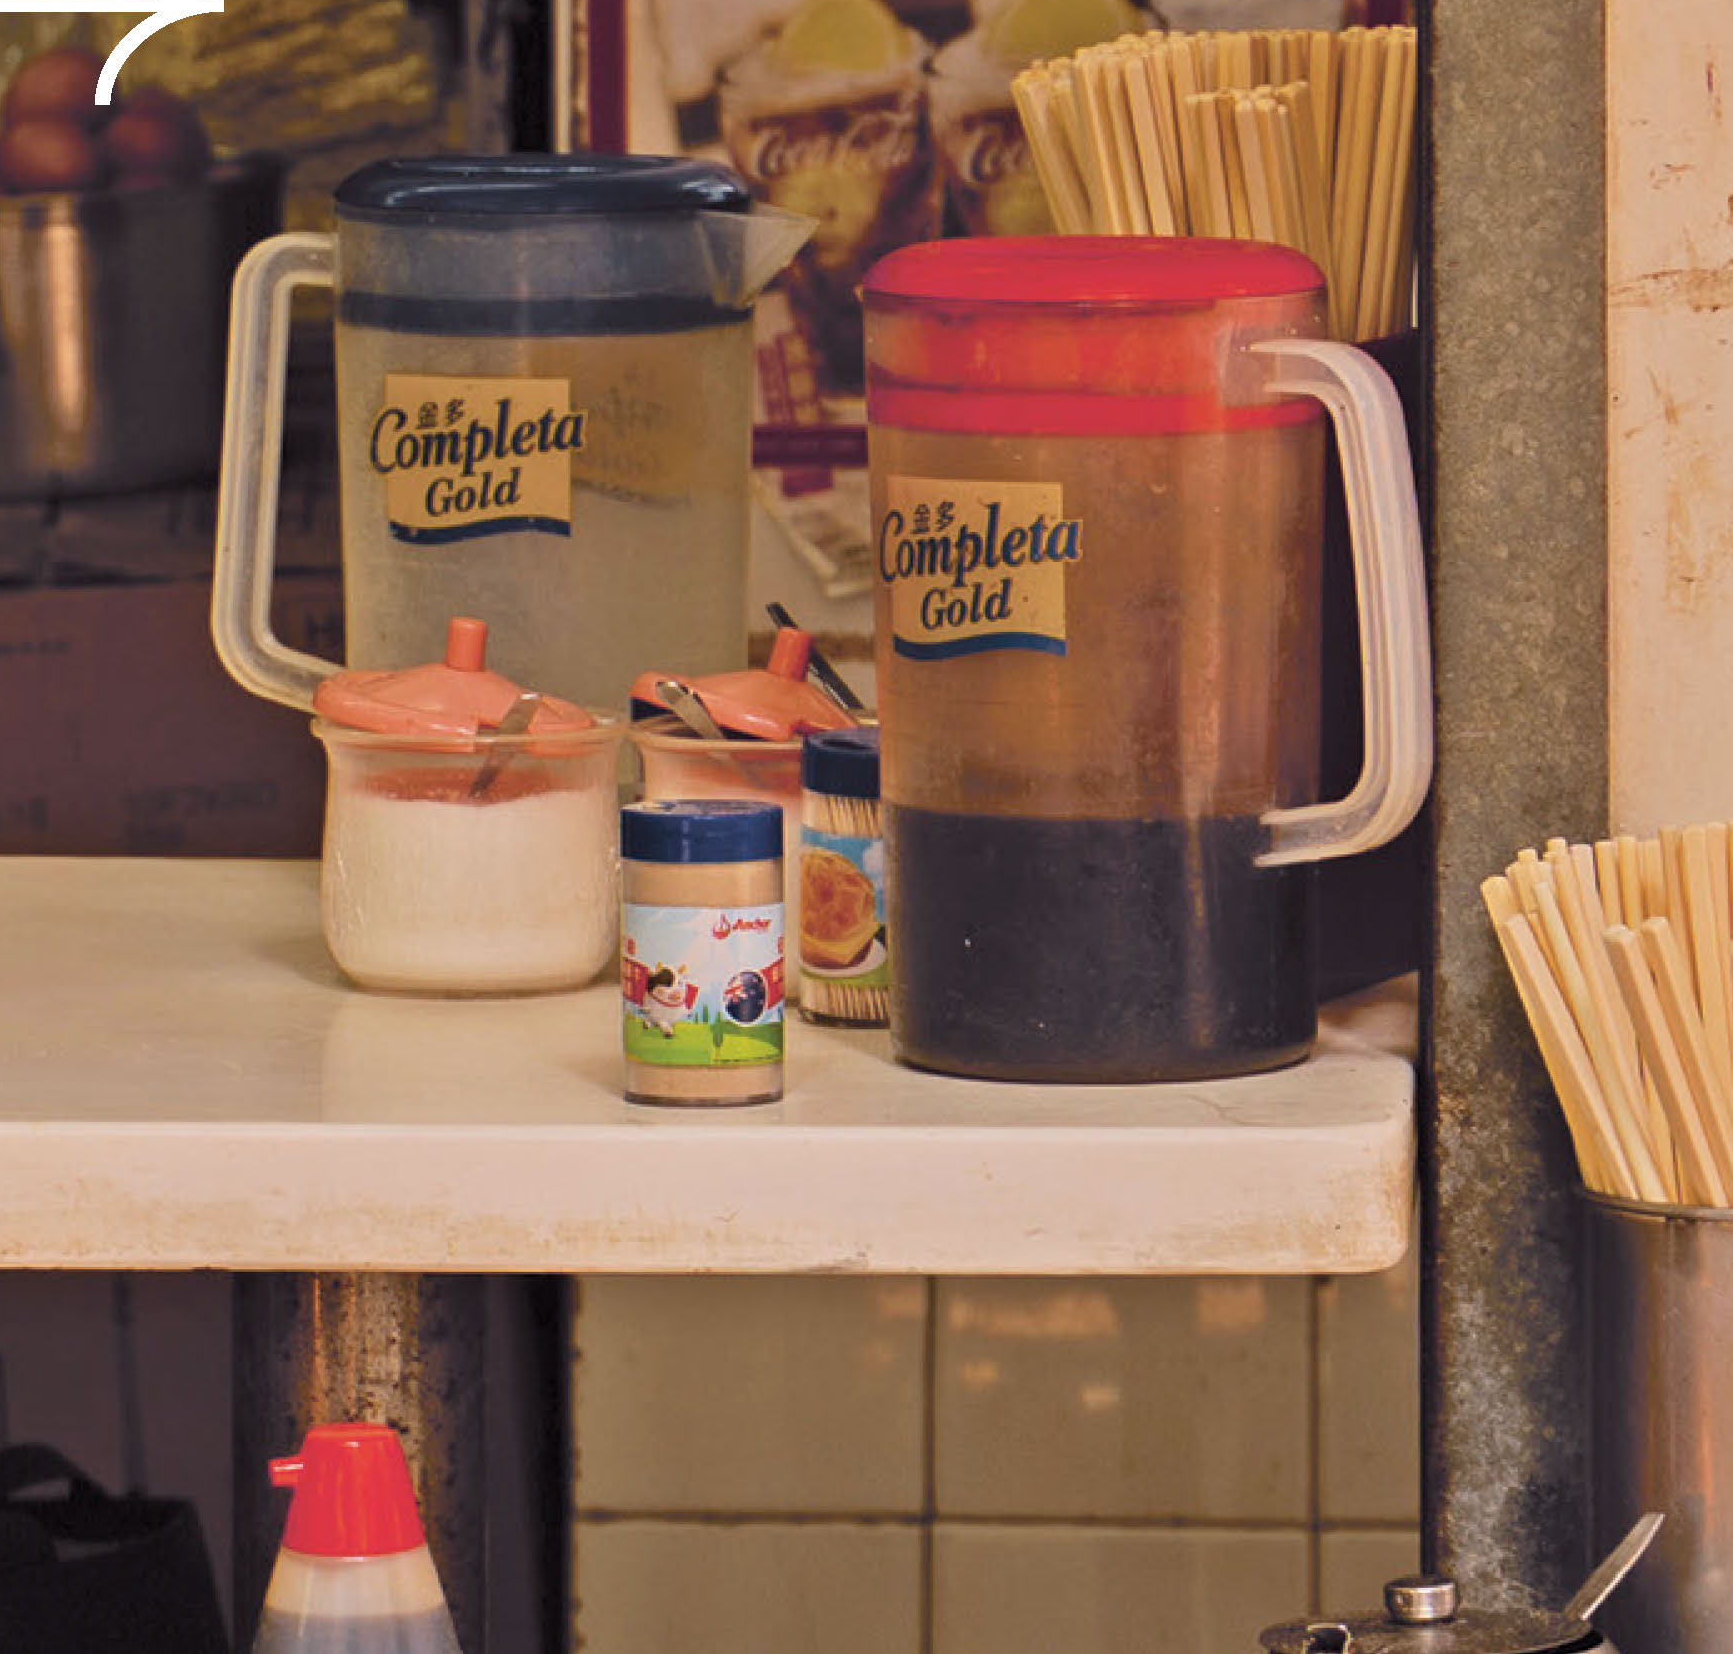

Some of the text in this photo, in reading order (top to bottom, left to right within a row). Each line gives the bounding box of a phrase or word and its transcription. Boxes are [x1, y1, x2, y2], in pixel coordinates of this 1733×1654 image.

[370, 398, 587, 477] Completa
[425, 466, 522, 517] Gold
[880, 501, 1080, 588] Completa
[921, 577, 1012, 630] Gold
